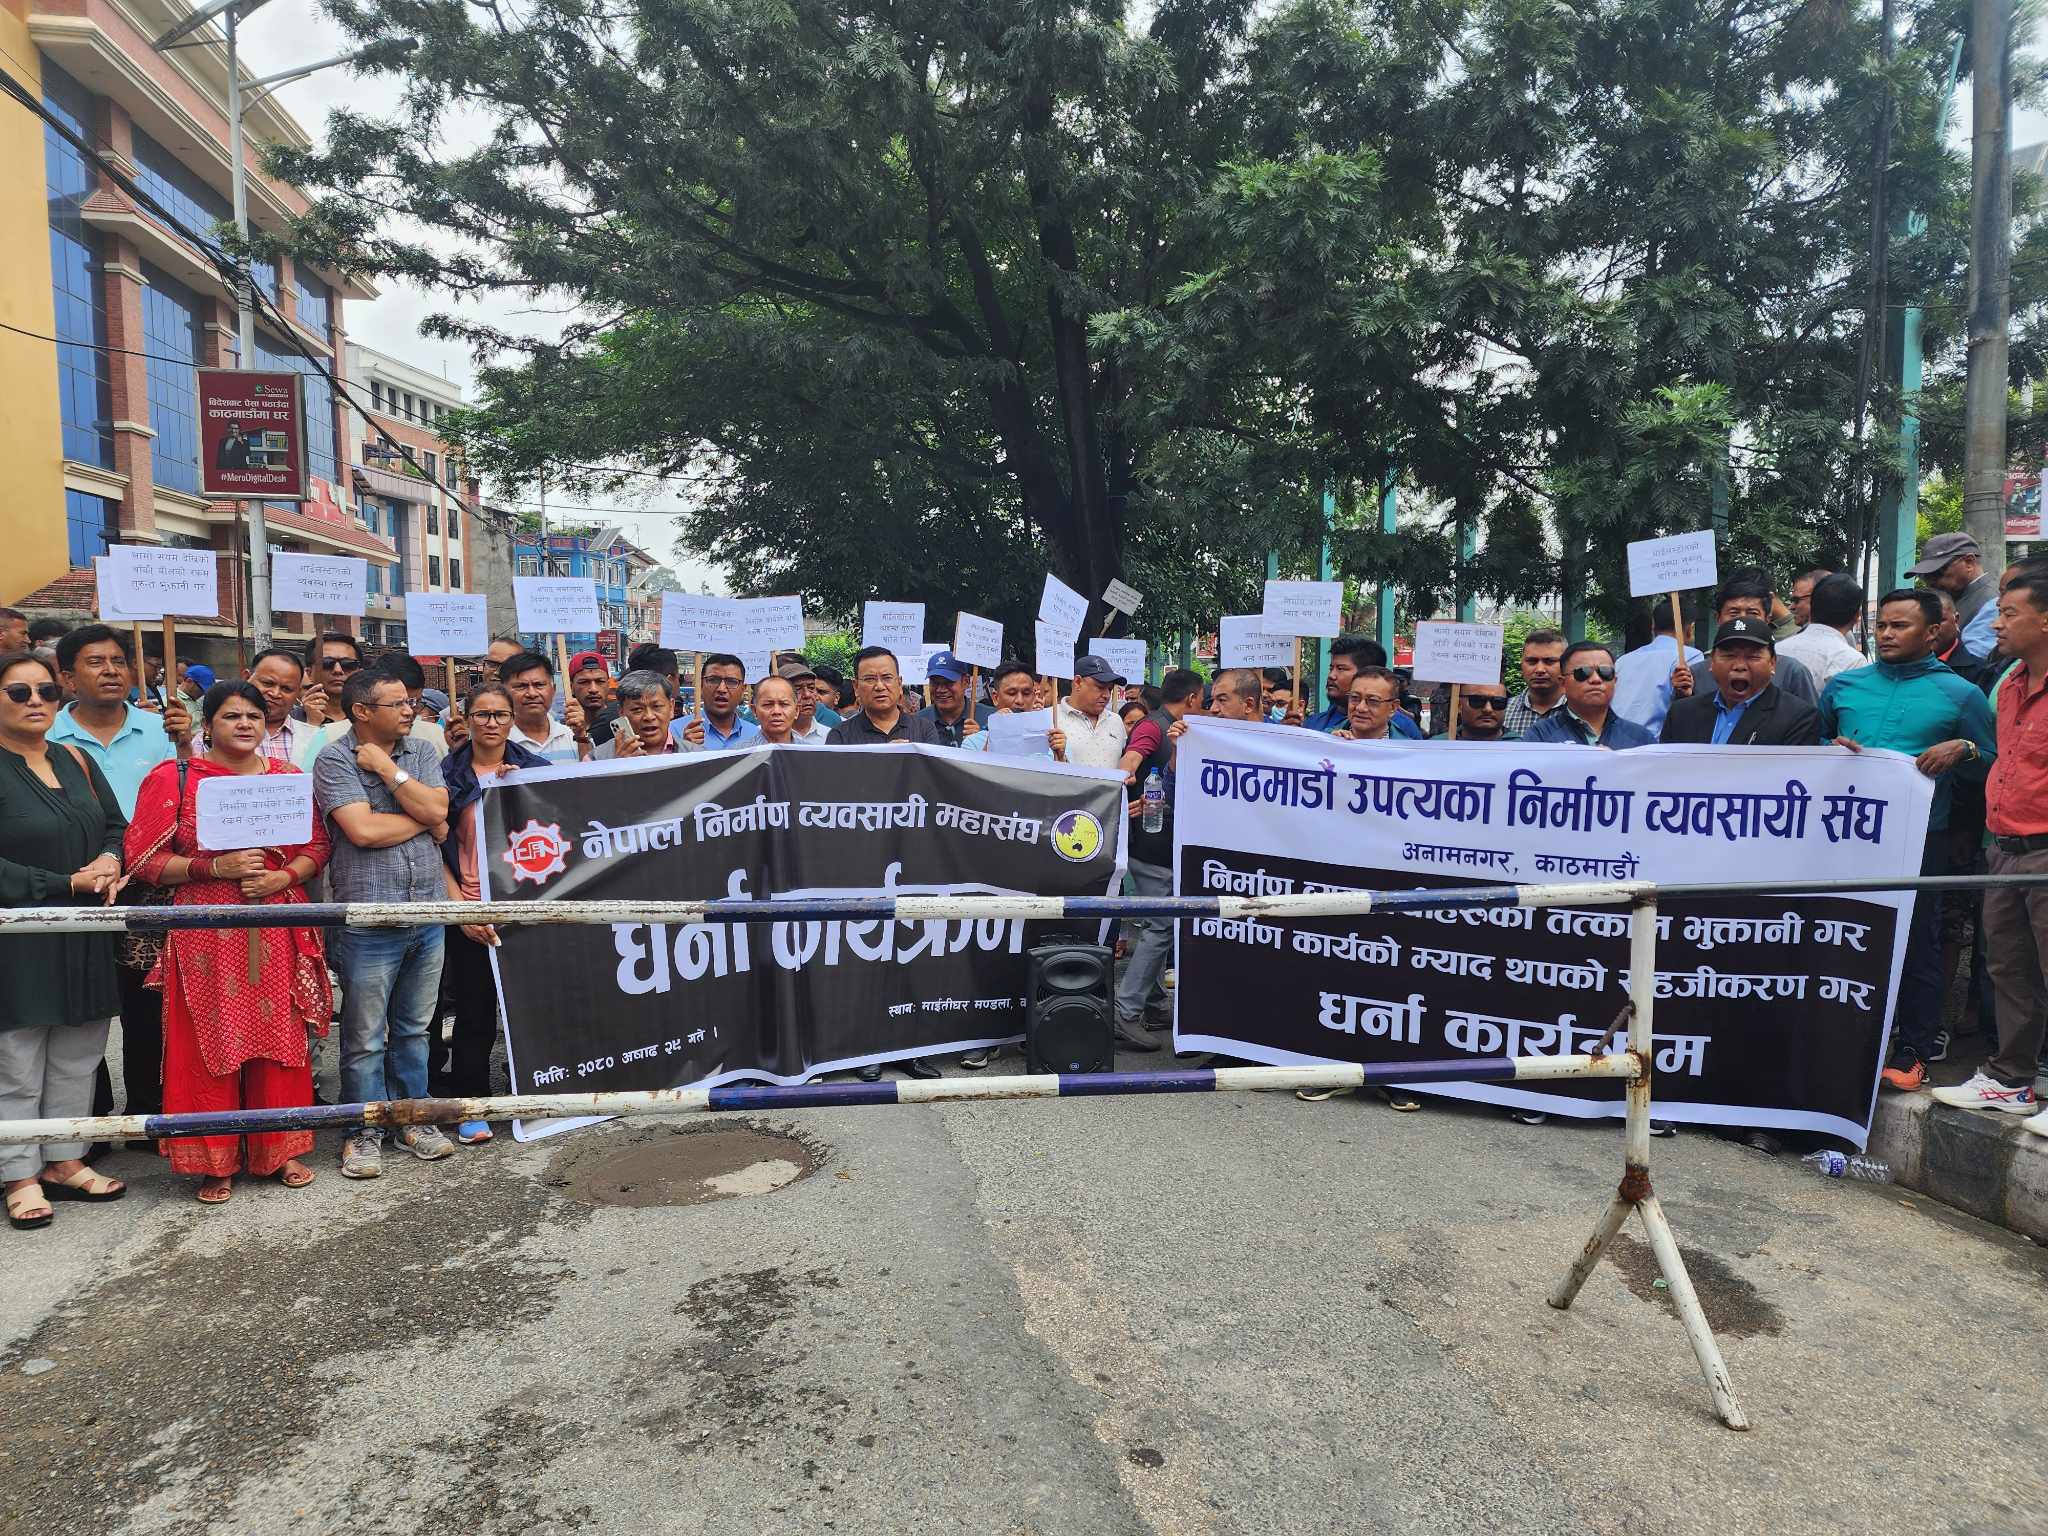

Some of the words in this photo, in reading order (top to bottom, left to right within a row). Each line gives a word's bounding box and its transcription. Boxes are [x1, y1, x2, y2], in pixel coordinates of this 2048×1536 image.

[273, 411, 290, 421] घर
[580, 819, 685, 860] नेपाल
[693, 795, 791, 842] निर्माण
[799, 793, 929, 832] व्यवसायी
[935, 802, 1043, 845] महासंघ
[1348, 773, 1496, 825] उपत्यका
[1508, 768, 1635, 834] निर्माण
[1646, 779, 1812, 842] व्यवसायी
[1821, 784, 1888, 845] संघ
[1402, 842, 1519, 874] अनामनगर,
[1201, 859, 1296, 896] निर्माण
[1683, 911, 1805, 950] भुक्तानी
[1814, 918, 1871, 952] गर
[1292, 925, 1401, 967] कार्यको
[1411, 946, 1496, 981] म्याद
[1505, 957, 1609, 992] थपको
[1819, 976, 1876, 1011] गर
[1318, 991, 1427, 1044] धर्ना
[533, 1065, 570, 1088] मिति:
[577, 1056, 614, 1077] २०८०
[687, 1028, 706, 1044] गते
